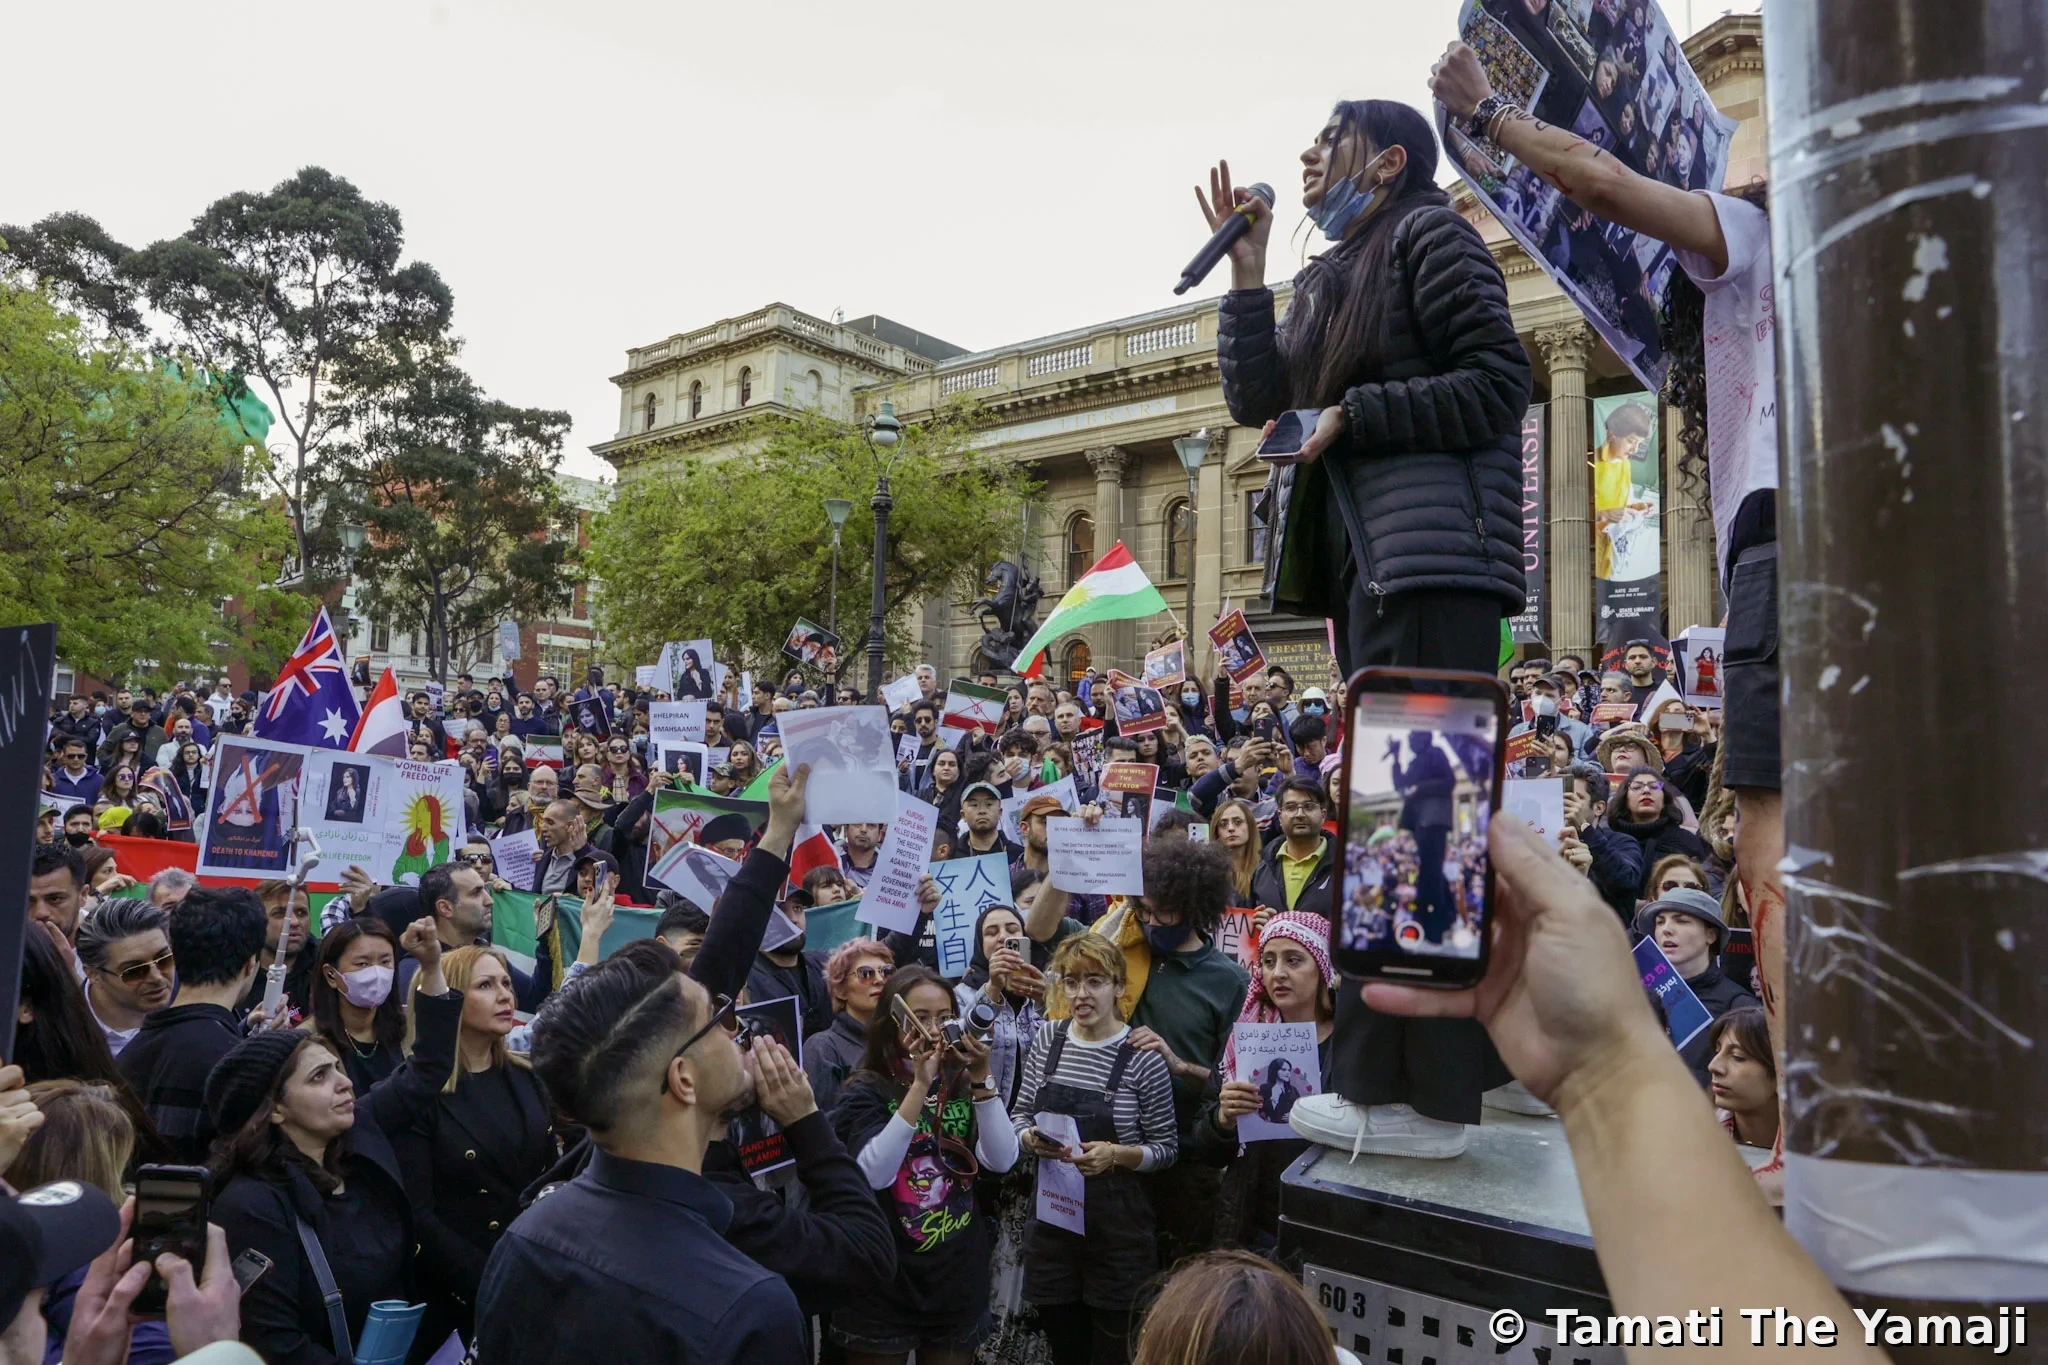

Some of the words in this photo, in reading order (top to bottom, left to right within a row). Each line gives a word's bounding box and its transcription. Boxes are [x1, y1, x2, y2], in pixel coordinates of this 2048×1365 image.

[1521, 417, 1539, 571] UNIVERSE
[1511, 615, 1538, 623] SPACES
[1268, 643, 1321, 654] ERECTED
[1268, 655, 1309, 663] GRATEFUL
[1509, 737, 1527, 748] DOWN
[401, 771, 441, 783] FREEDOM
[906, 809, 925, 821] KURDISH
[893, 826, 910, 838] KILLED
[898, 816, 916, 830] PEOPLE
[916, 822, 928, 834] WERE
[211, 846, 234, 855] DEATH
[234, 847, 242, 856] TO
[897, 838, 905, 847] THE
[905, 840, 923, 852] RECENT
[328, 852, 341, 860] LIFE
[342, 853, 373, 862] FREEDOM
[896, 848, 920, 862] PROTESTS
[890, 857, 911, 869] AGAINST
[911, 863, 921, 872] THE
[892, 868, 913, 880] IRANIAN
[881, 875, 916, 891] GOVERNMENT
[880, 886, 901, 898] MURDER
[901, 891, 909, 899] OF
[875, 895, 891, 906] ZHINA
[891, 899, 906, 909] AMINI
[739, 1140, 765, 1156] TAND
[756, 1147, 781, 1164] AMINI
[1042, 1189, 1060, 1200] DOWN
[1060, 1194, 1074, 1205] WITH
[1050, 1202, 1076, 1217] DICTATOR
[914, 1205, 972, 1253] Steve
